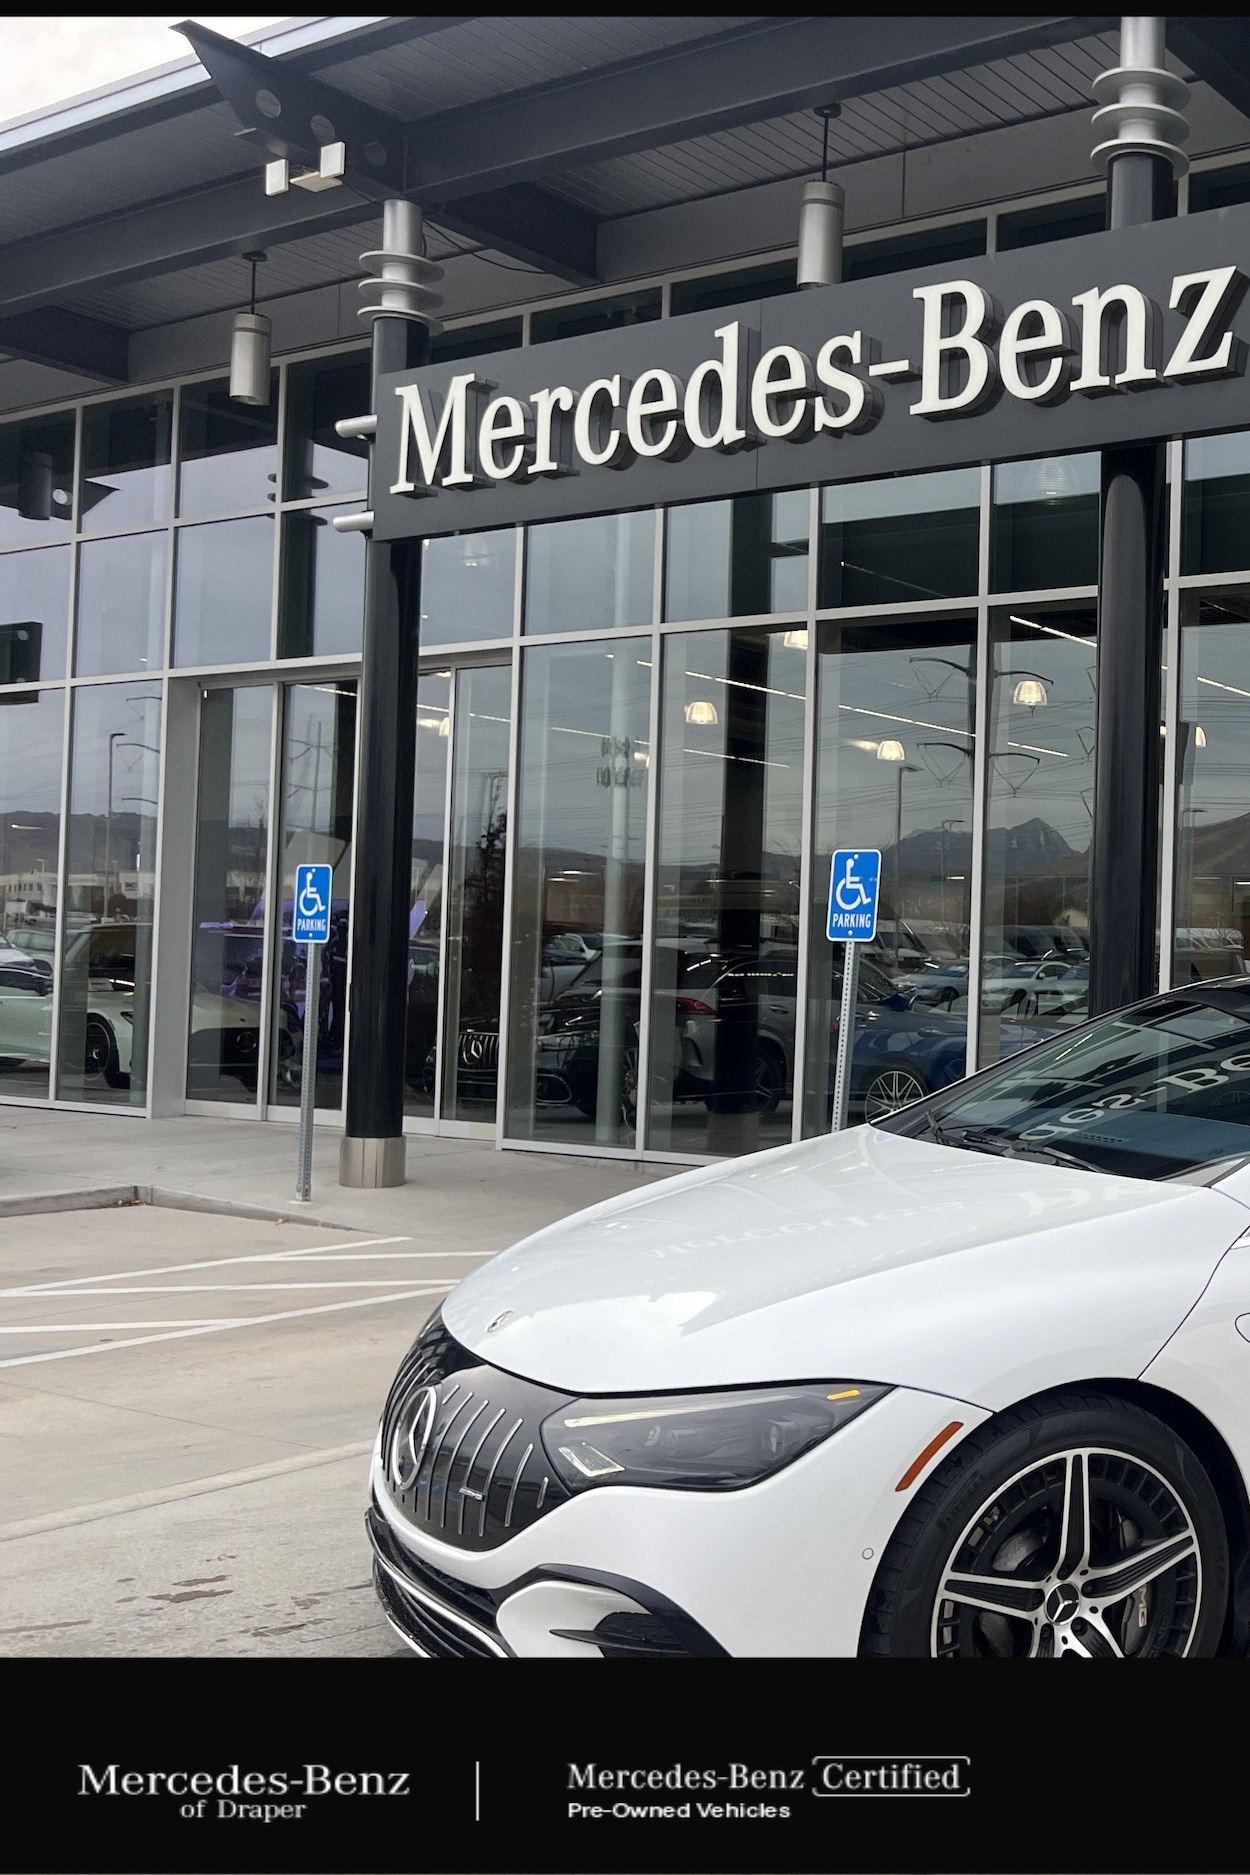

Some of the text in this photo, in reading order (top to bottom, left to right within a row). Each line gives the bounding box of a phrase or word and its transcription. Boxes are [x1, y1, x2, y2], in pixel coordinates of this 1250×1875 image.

[389, 264, 1239, 496] Mercedes-Benz
[297, 918, 326, 931] PARKING
[832, 912, 872, 929] PARKING
